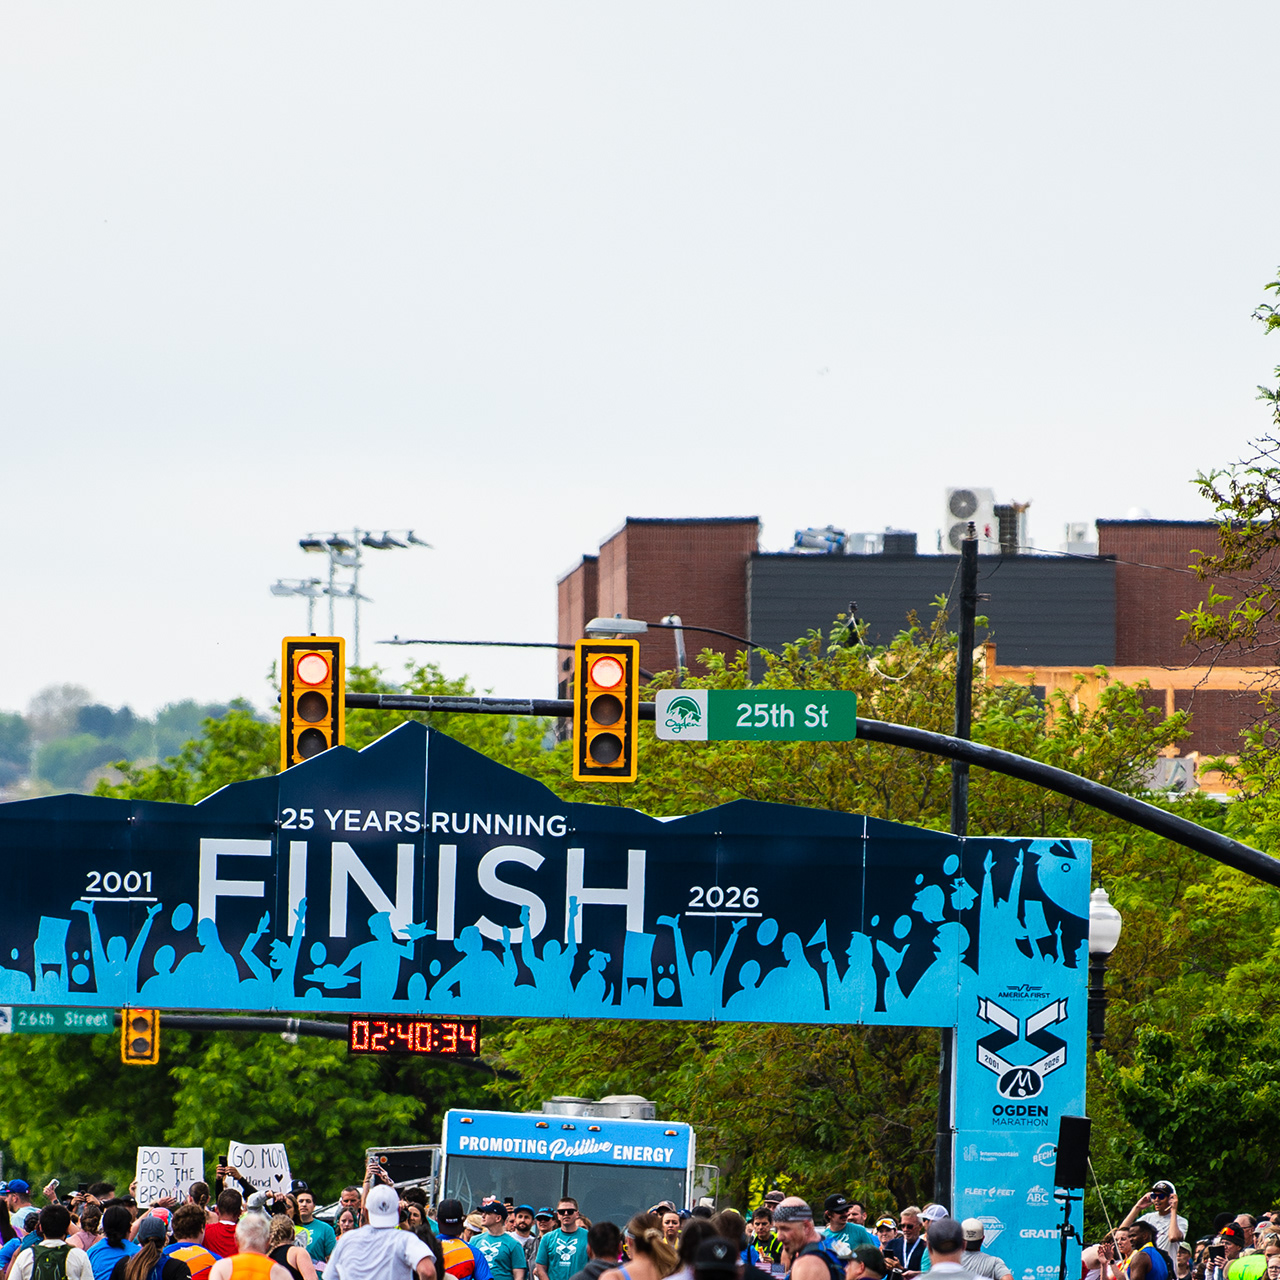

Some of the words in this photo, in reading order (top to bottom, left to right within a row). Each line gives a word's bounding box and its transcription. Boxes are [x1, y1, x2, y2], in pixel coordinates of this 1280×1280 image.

[735, 703, 795, 727] 25th
[804, 703, 829, 727] St
[665, 718, 702, 734] Ogden
[281, 808, 314, 830] 25
[324, 809, 421, 833] YEARS
[431, 812, 568, 837] RUNNING
[85, 871, 153, 893] 2001
[197, 838, 646, 945] FINISH
[687, 885, 761, 909] 2026
[18, 1010, 55, 1026] 26th
[64, 1011, 108, 1026] Street
[351, 1020, 477, 1053] 02:40:34
[984, 1054, 1000, 1070] 2001
[1043, 1056, 1060, 1071] 2026
[992, 1105, 1049, 1117] OGDEN
[992, 1118, 1049, 1126] MARATHON
[459, 1135, 547, 1155] PROMOTING
[548, 1137, 613, 1160] Positive
[613, 1145, 674, 1163] ENERGY
[142, 1150, 161, 1165] DO
[170, 1152, 188, 1166] IT
[140, 1168, 165, 1183] FOR
[174, 1167, 195, 1181] THE
[965, 1188, 988, 1196] FLEET
[1026, 1193, 1049, 1203] ABC
[1036, 1265, 1061, 1273] GOA
